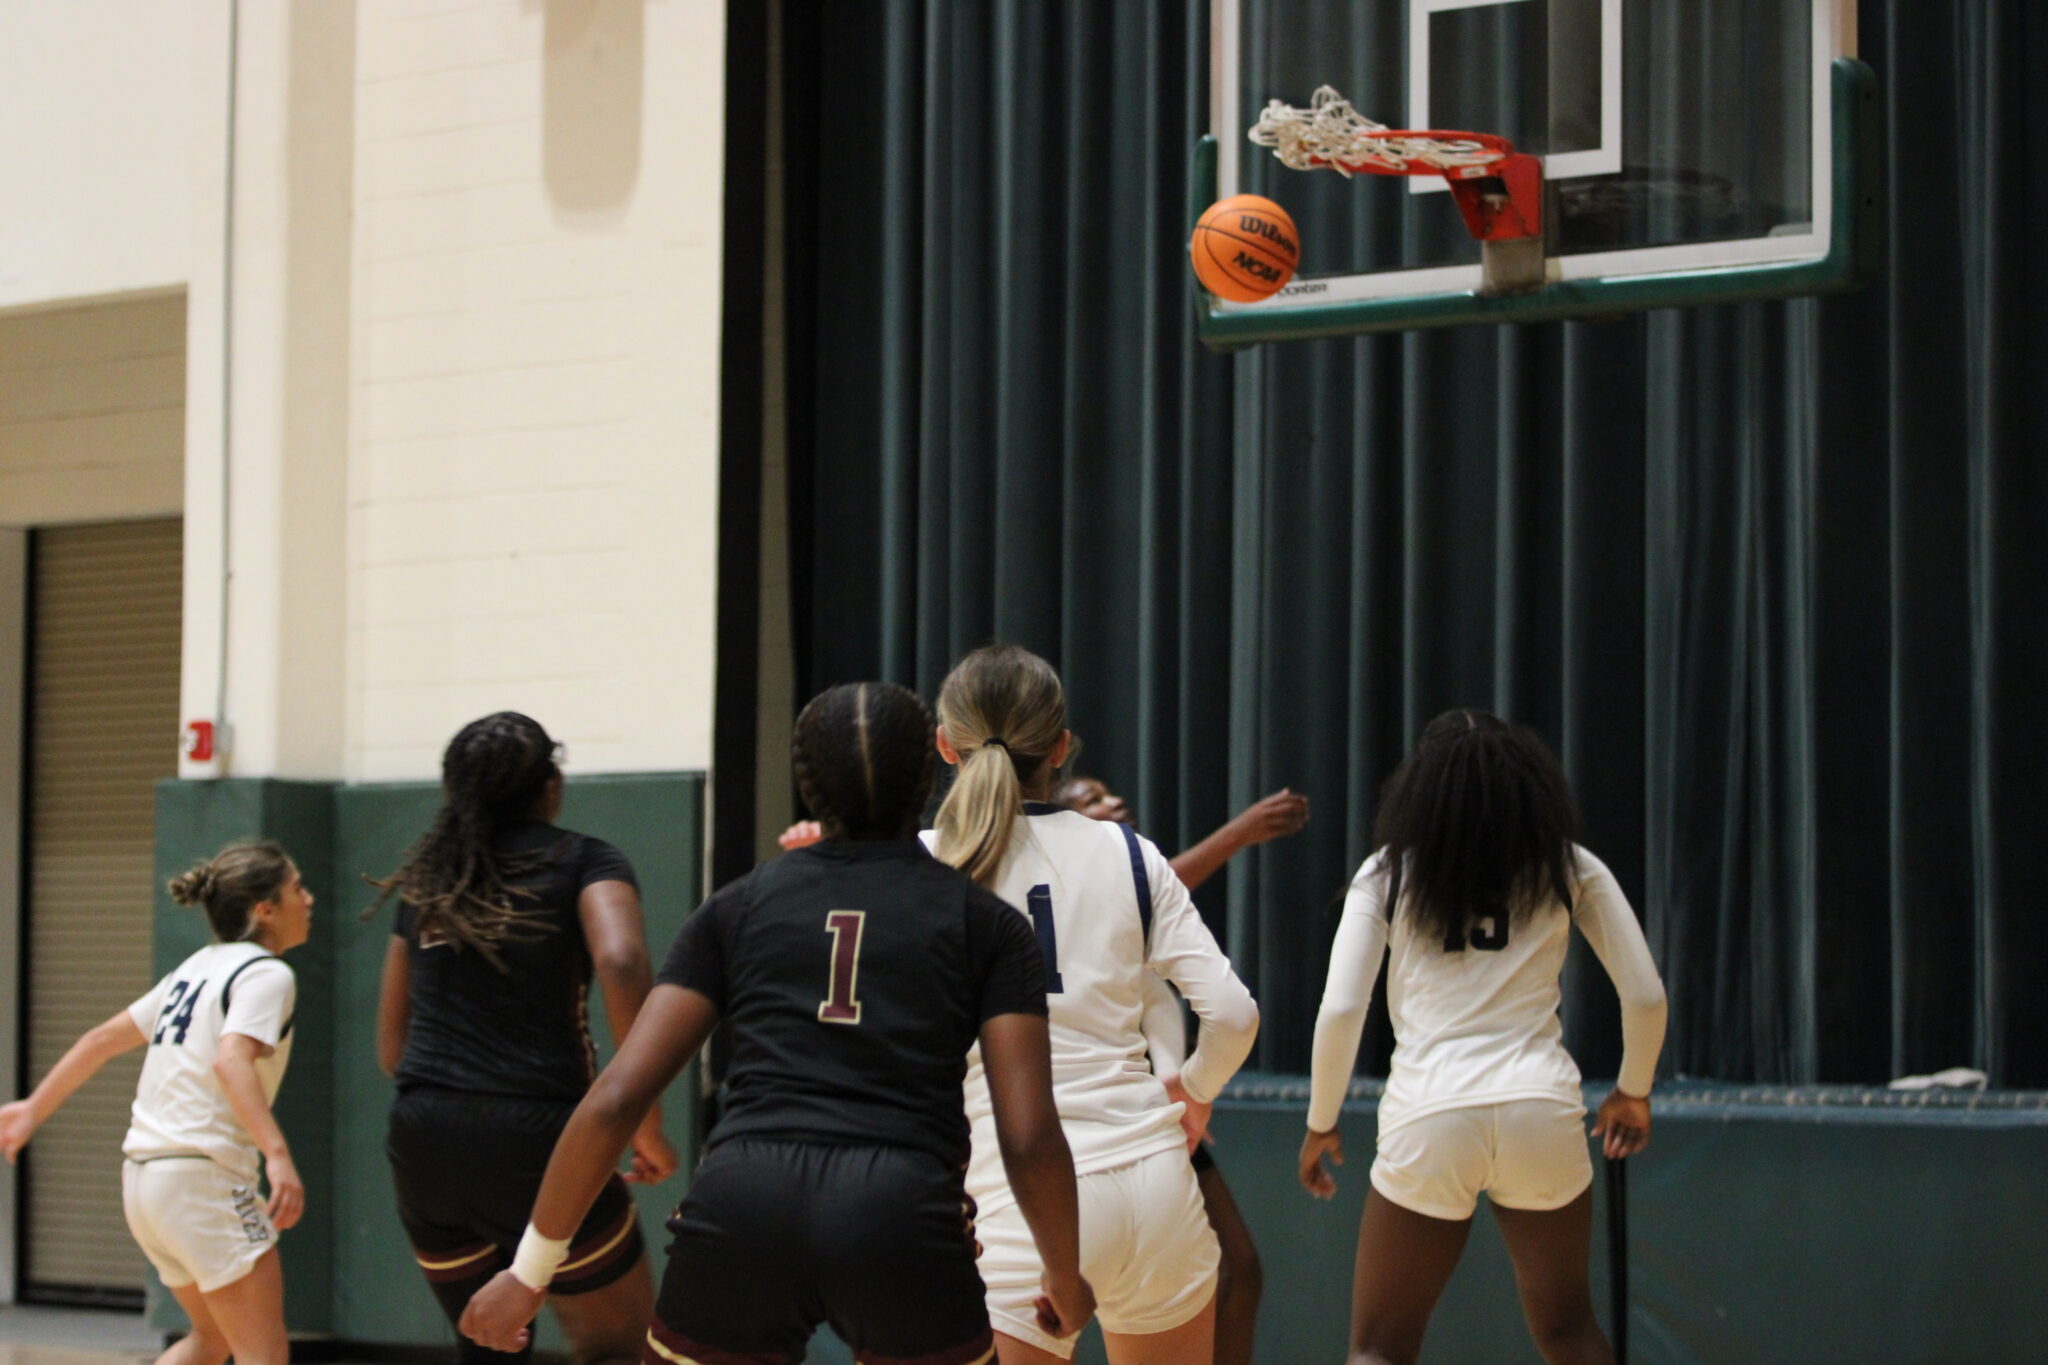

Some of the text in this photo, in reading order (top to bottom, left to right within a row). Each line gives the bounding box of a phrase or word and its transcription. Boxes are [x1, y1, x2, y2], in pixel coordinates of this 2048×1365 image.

[1232, 250, 1283, 285] NCAA
[817, 910, 866, 1025] 1
[1025, 883, 1064, 994] 1
[152, 979, 208, 1045] 24
